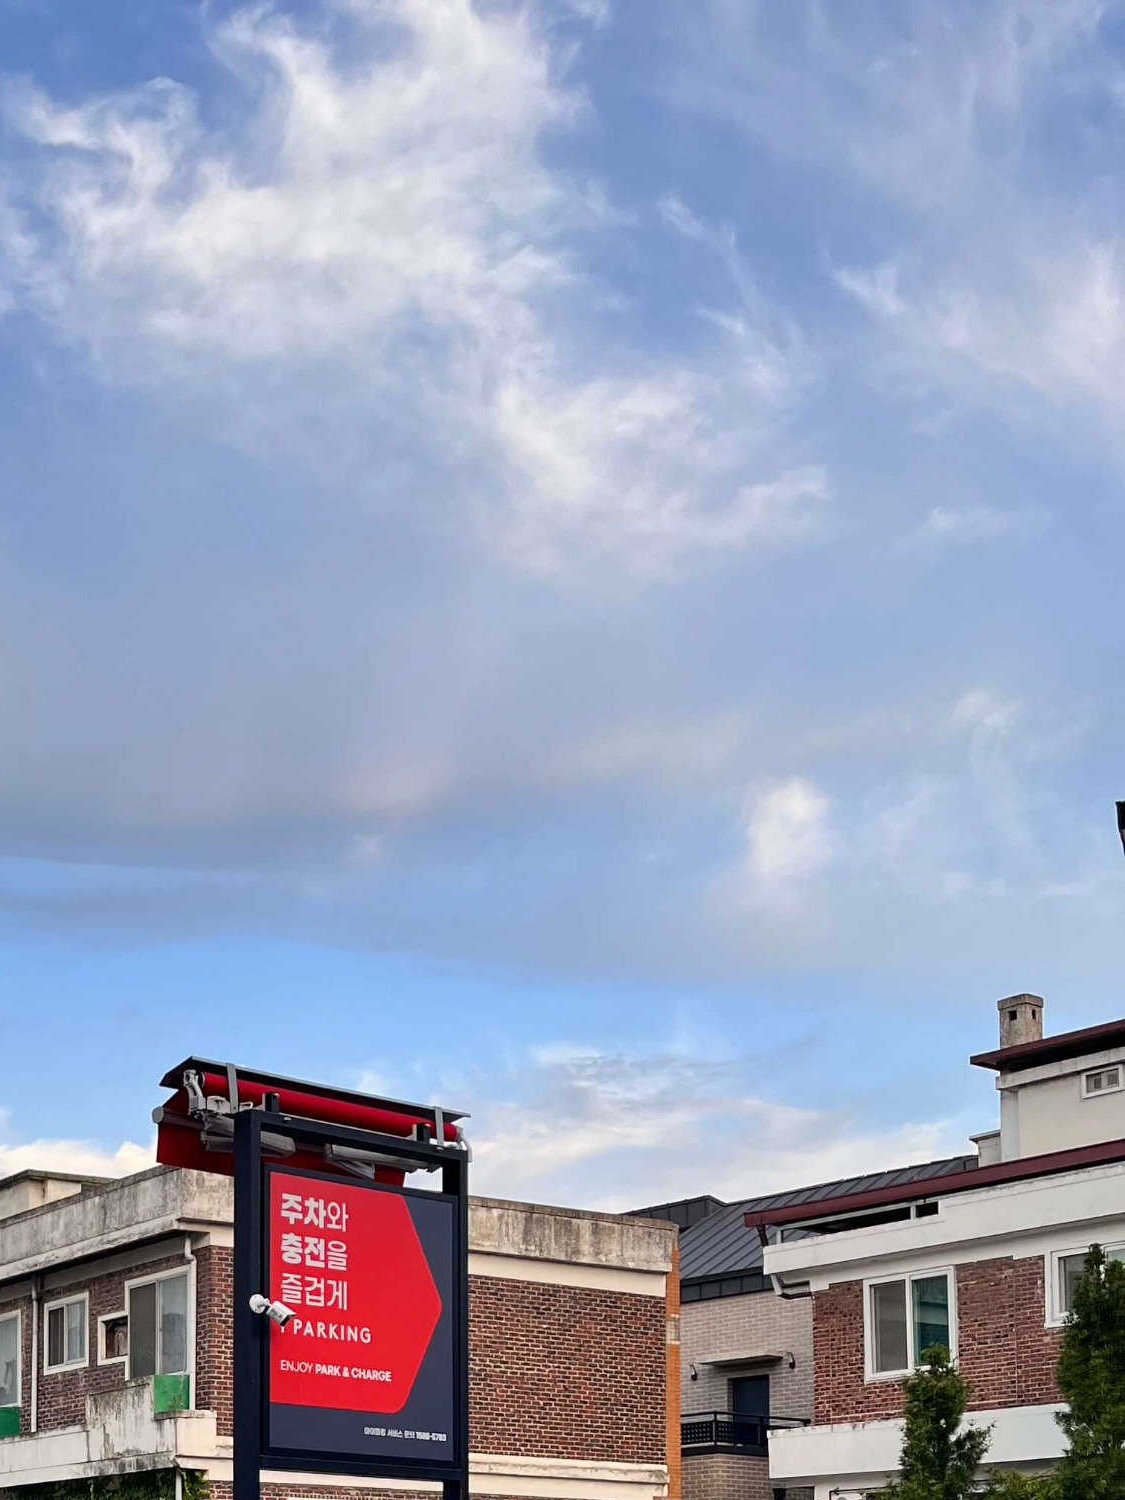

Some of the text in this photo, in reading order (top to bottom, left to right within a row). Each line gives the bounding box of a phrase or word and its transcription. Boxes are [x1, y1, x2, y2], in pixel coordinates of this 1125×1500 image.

[280, 1193, 349, 1232] 주차와
[280, 1232, 348, 1272] 충전을
[280, 1272, 348, 1311] 즐겁게
[293, 1319, 371, 1343] PARKING
[280, 1359, 392, 1382] ENJOY PARK & CHARGE
